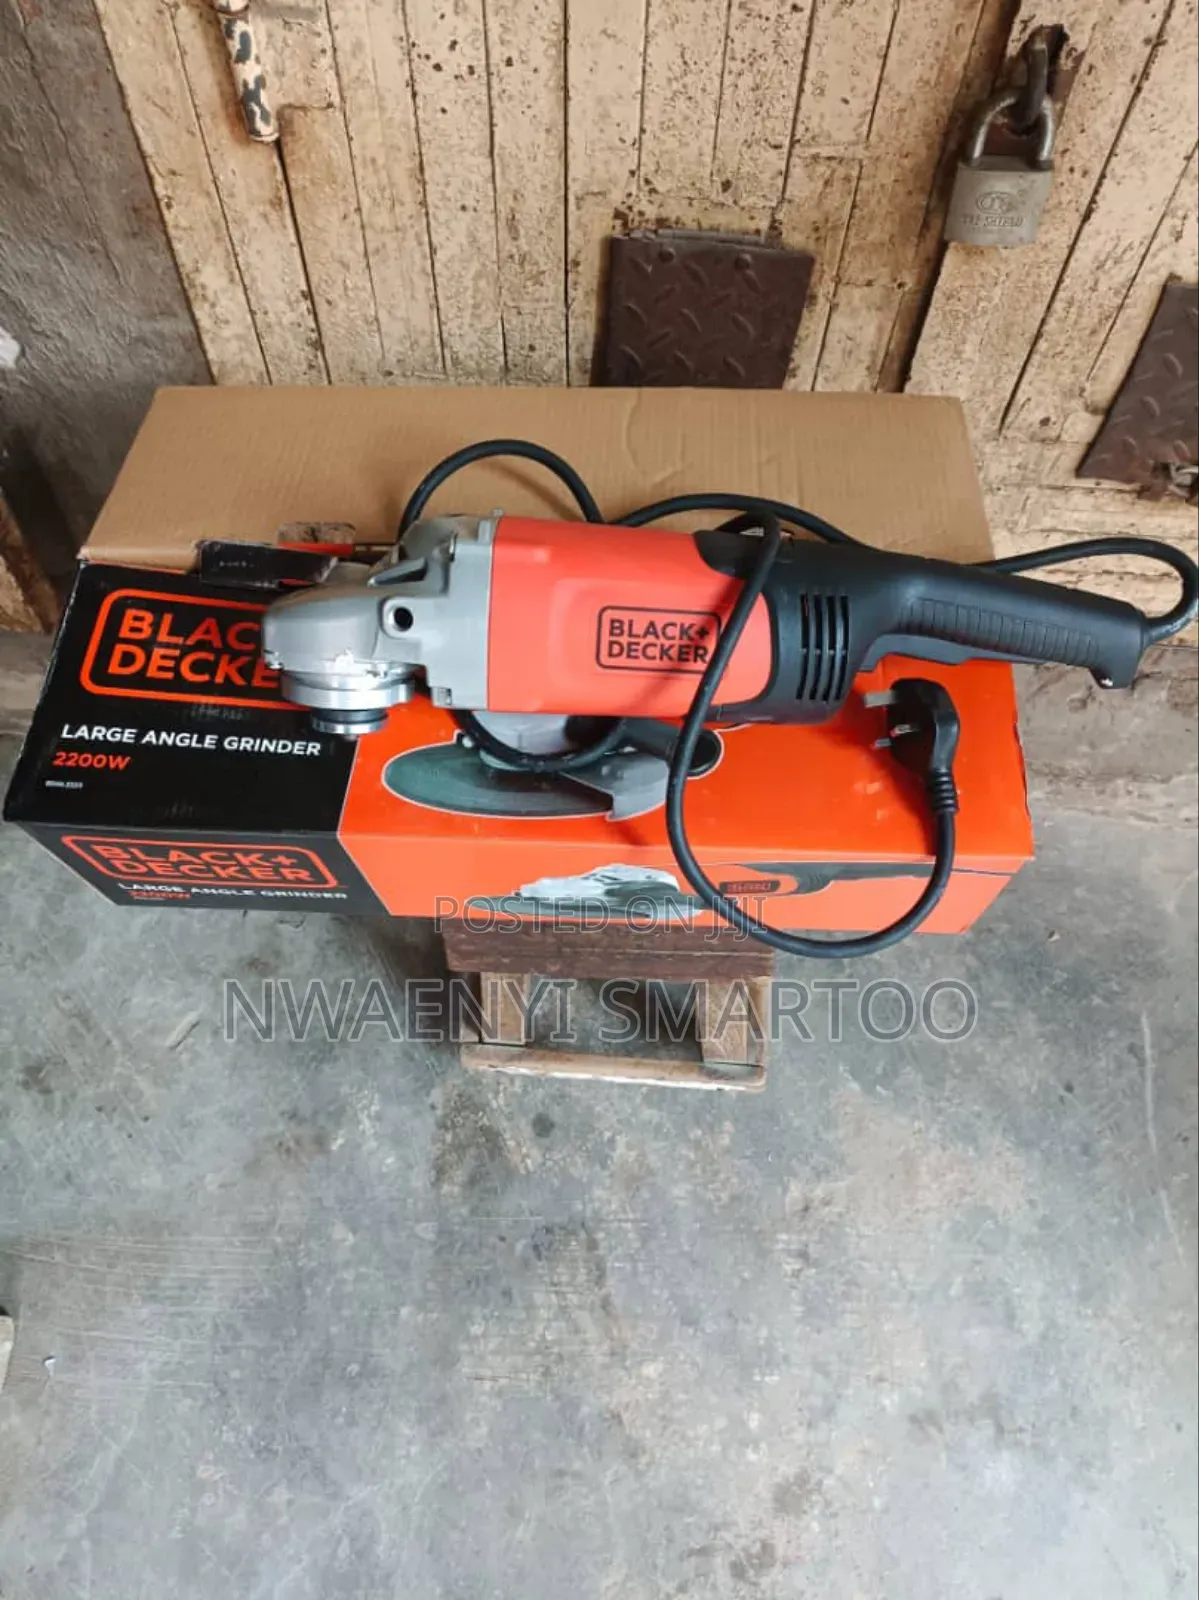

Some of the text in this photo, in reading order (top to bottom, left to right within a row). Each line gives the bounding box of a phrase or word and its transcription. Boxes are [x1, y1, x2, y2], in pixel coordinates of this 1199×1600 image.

[118, 608, 261, 651] BLAC
[609, 618, 709, 641] BLACK+
[607, 640, 708, 664] DECKER
[108, 643, 280, 688] DECKE
[61, 723, 321, 756] LARGE ANGLE GRINDER
[52, 751, 131, 771] 2200W
[90, 845, 298, 866] BLACK+
[109, 860, 316, 881] DECKER
